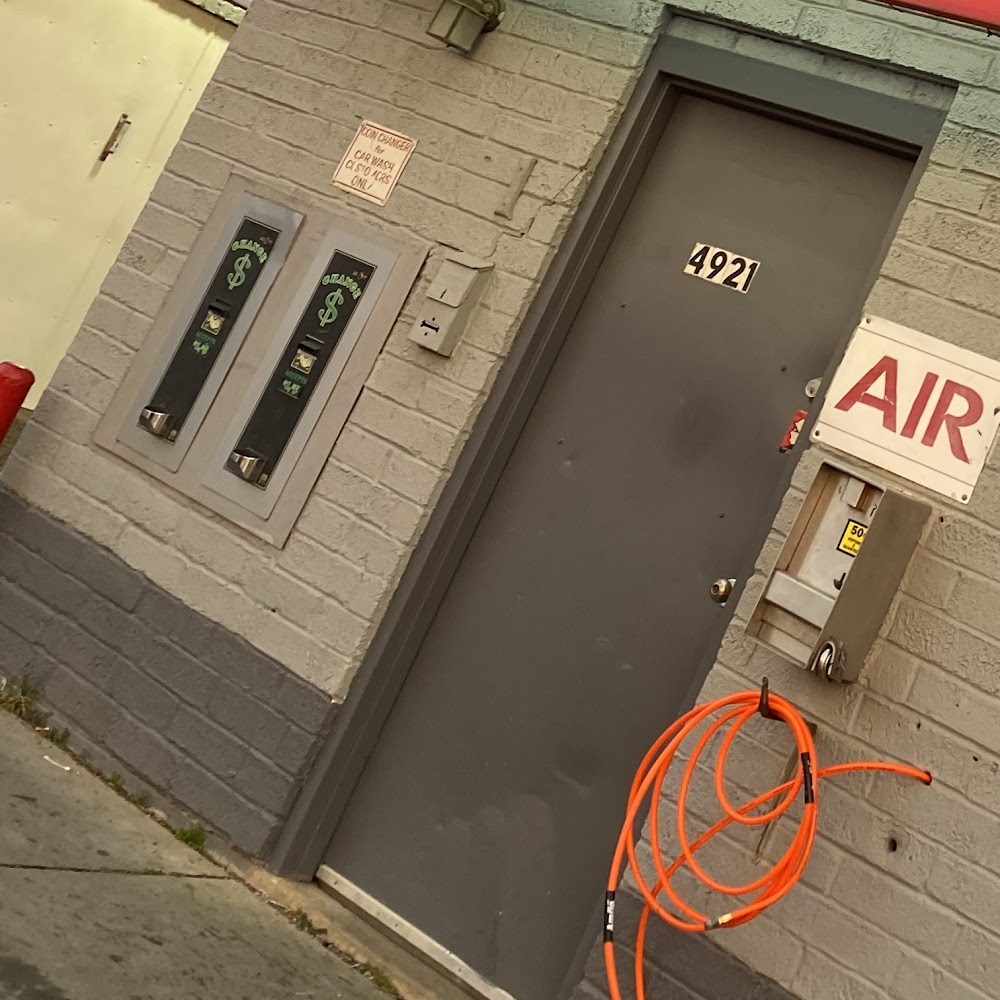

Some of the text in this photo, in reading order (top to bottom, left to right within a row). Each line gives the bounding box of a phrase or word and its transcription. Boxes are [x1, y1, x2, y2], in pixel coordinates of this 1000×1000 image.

[361, 126, 411, 153] COIN CHANGER
[353, 149, 395, 173] CAR WASH
[231, 239, 267, 264] CHANGE
[227, 253, 251, 290] $
[688, 245, 758, 291] 4921
[321, 273, 361, 300] CHANGE
[318, 288, 344, 327] $
[834, 355, 984, 465] AIR
[850, 525, 866, 538] 50
